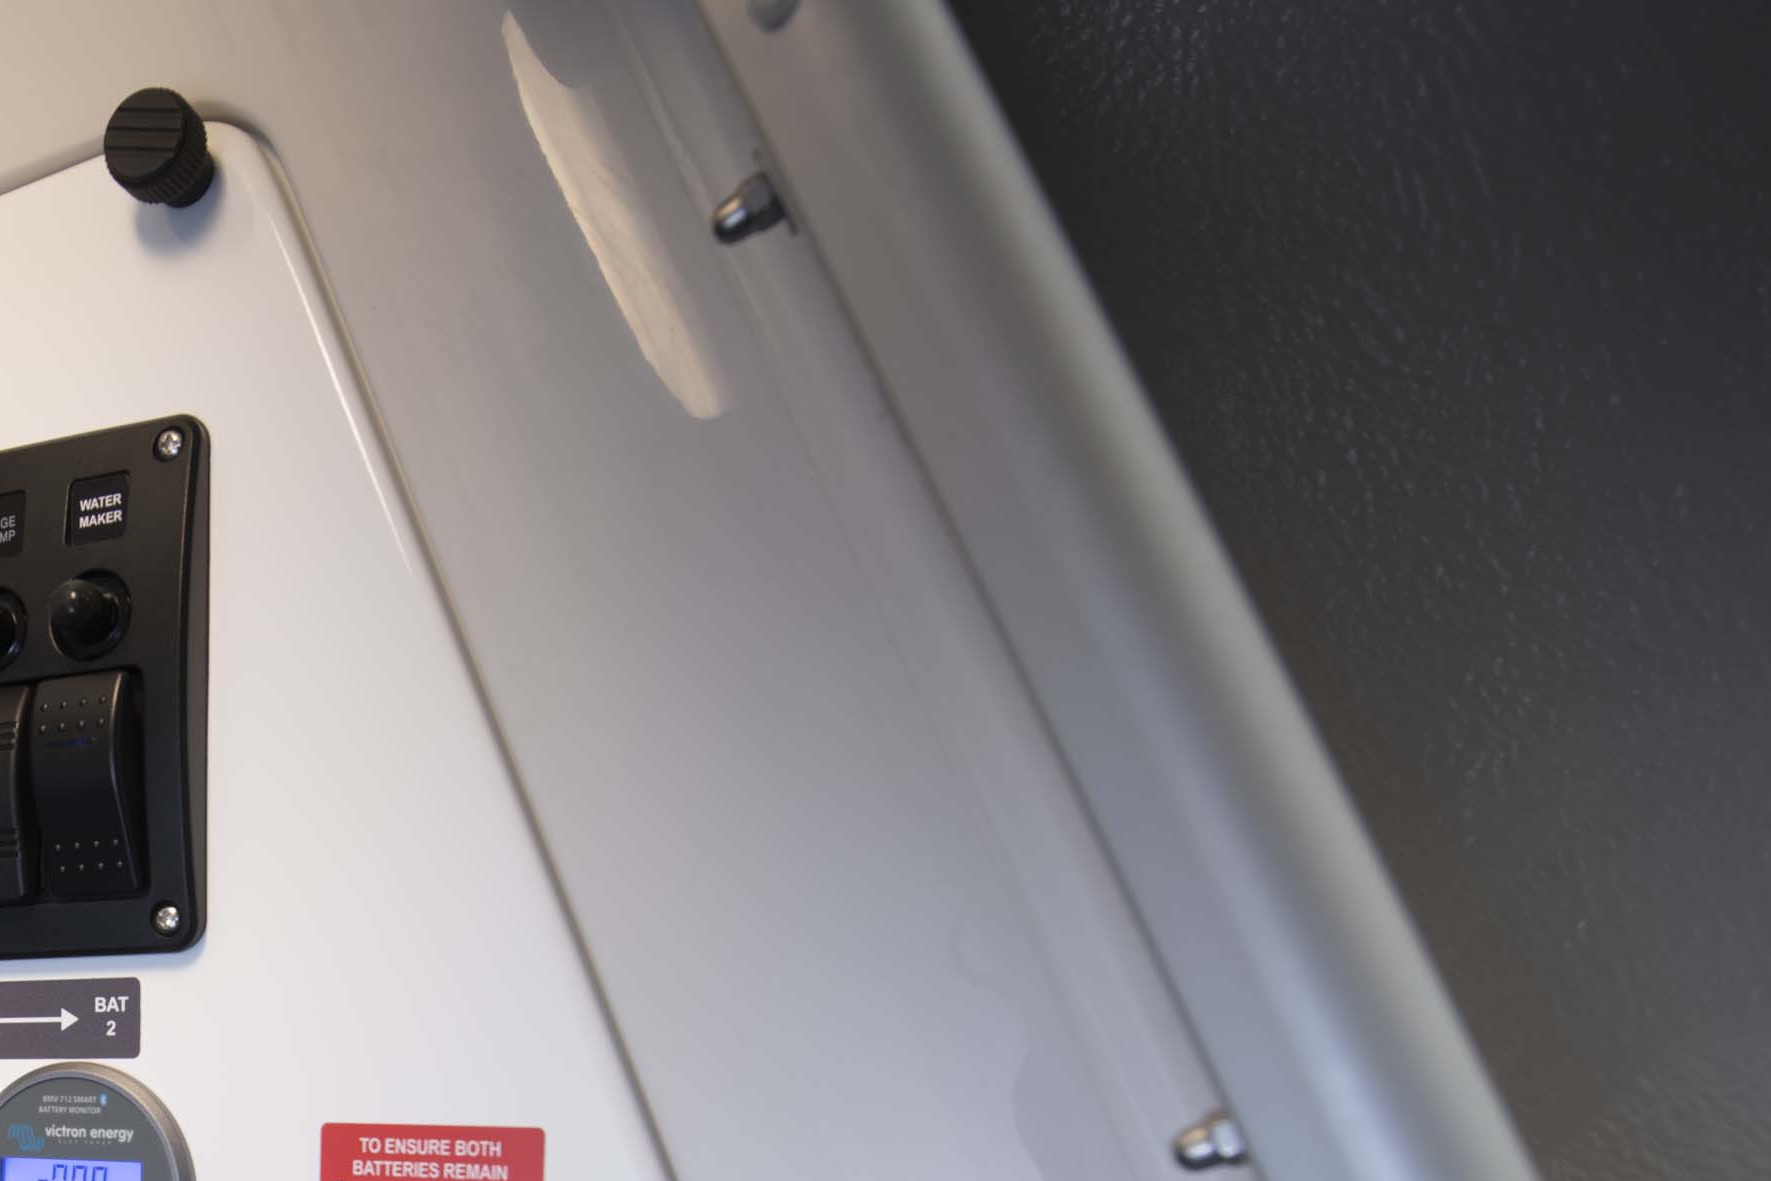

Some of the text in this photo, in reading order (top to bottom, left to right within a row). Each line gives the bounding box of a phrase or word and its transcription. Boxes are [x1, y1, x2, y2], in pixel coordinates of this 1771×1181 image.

[79, 493, 122, 512] WATER
[79, 510, 122, 529] MAKER
[95, 996, 129, 1012] BAT
[106, 1020, 116, 1036] 2
[43, 1095, 72, 1103] BMV-712
[45, 1124, 134, 1142] victron energy
[359, 1137, 501, 1157] TO ENSURE BOTH
[352, 1159, 508, 1181] BATTERIES REMAIN
